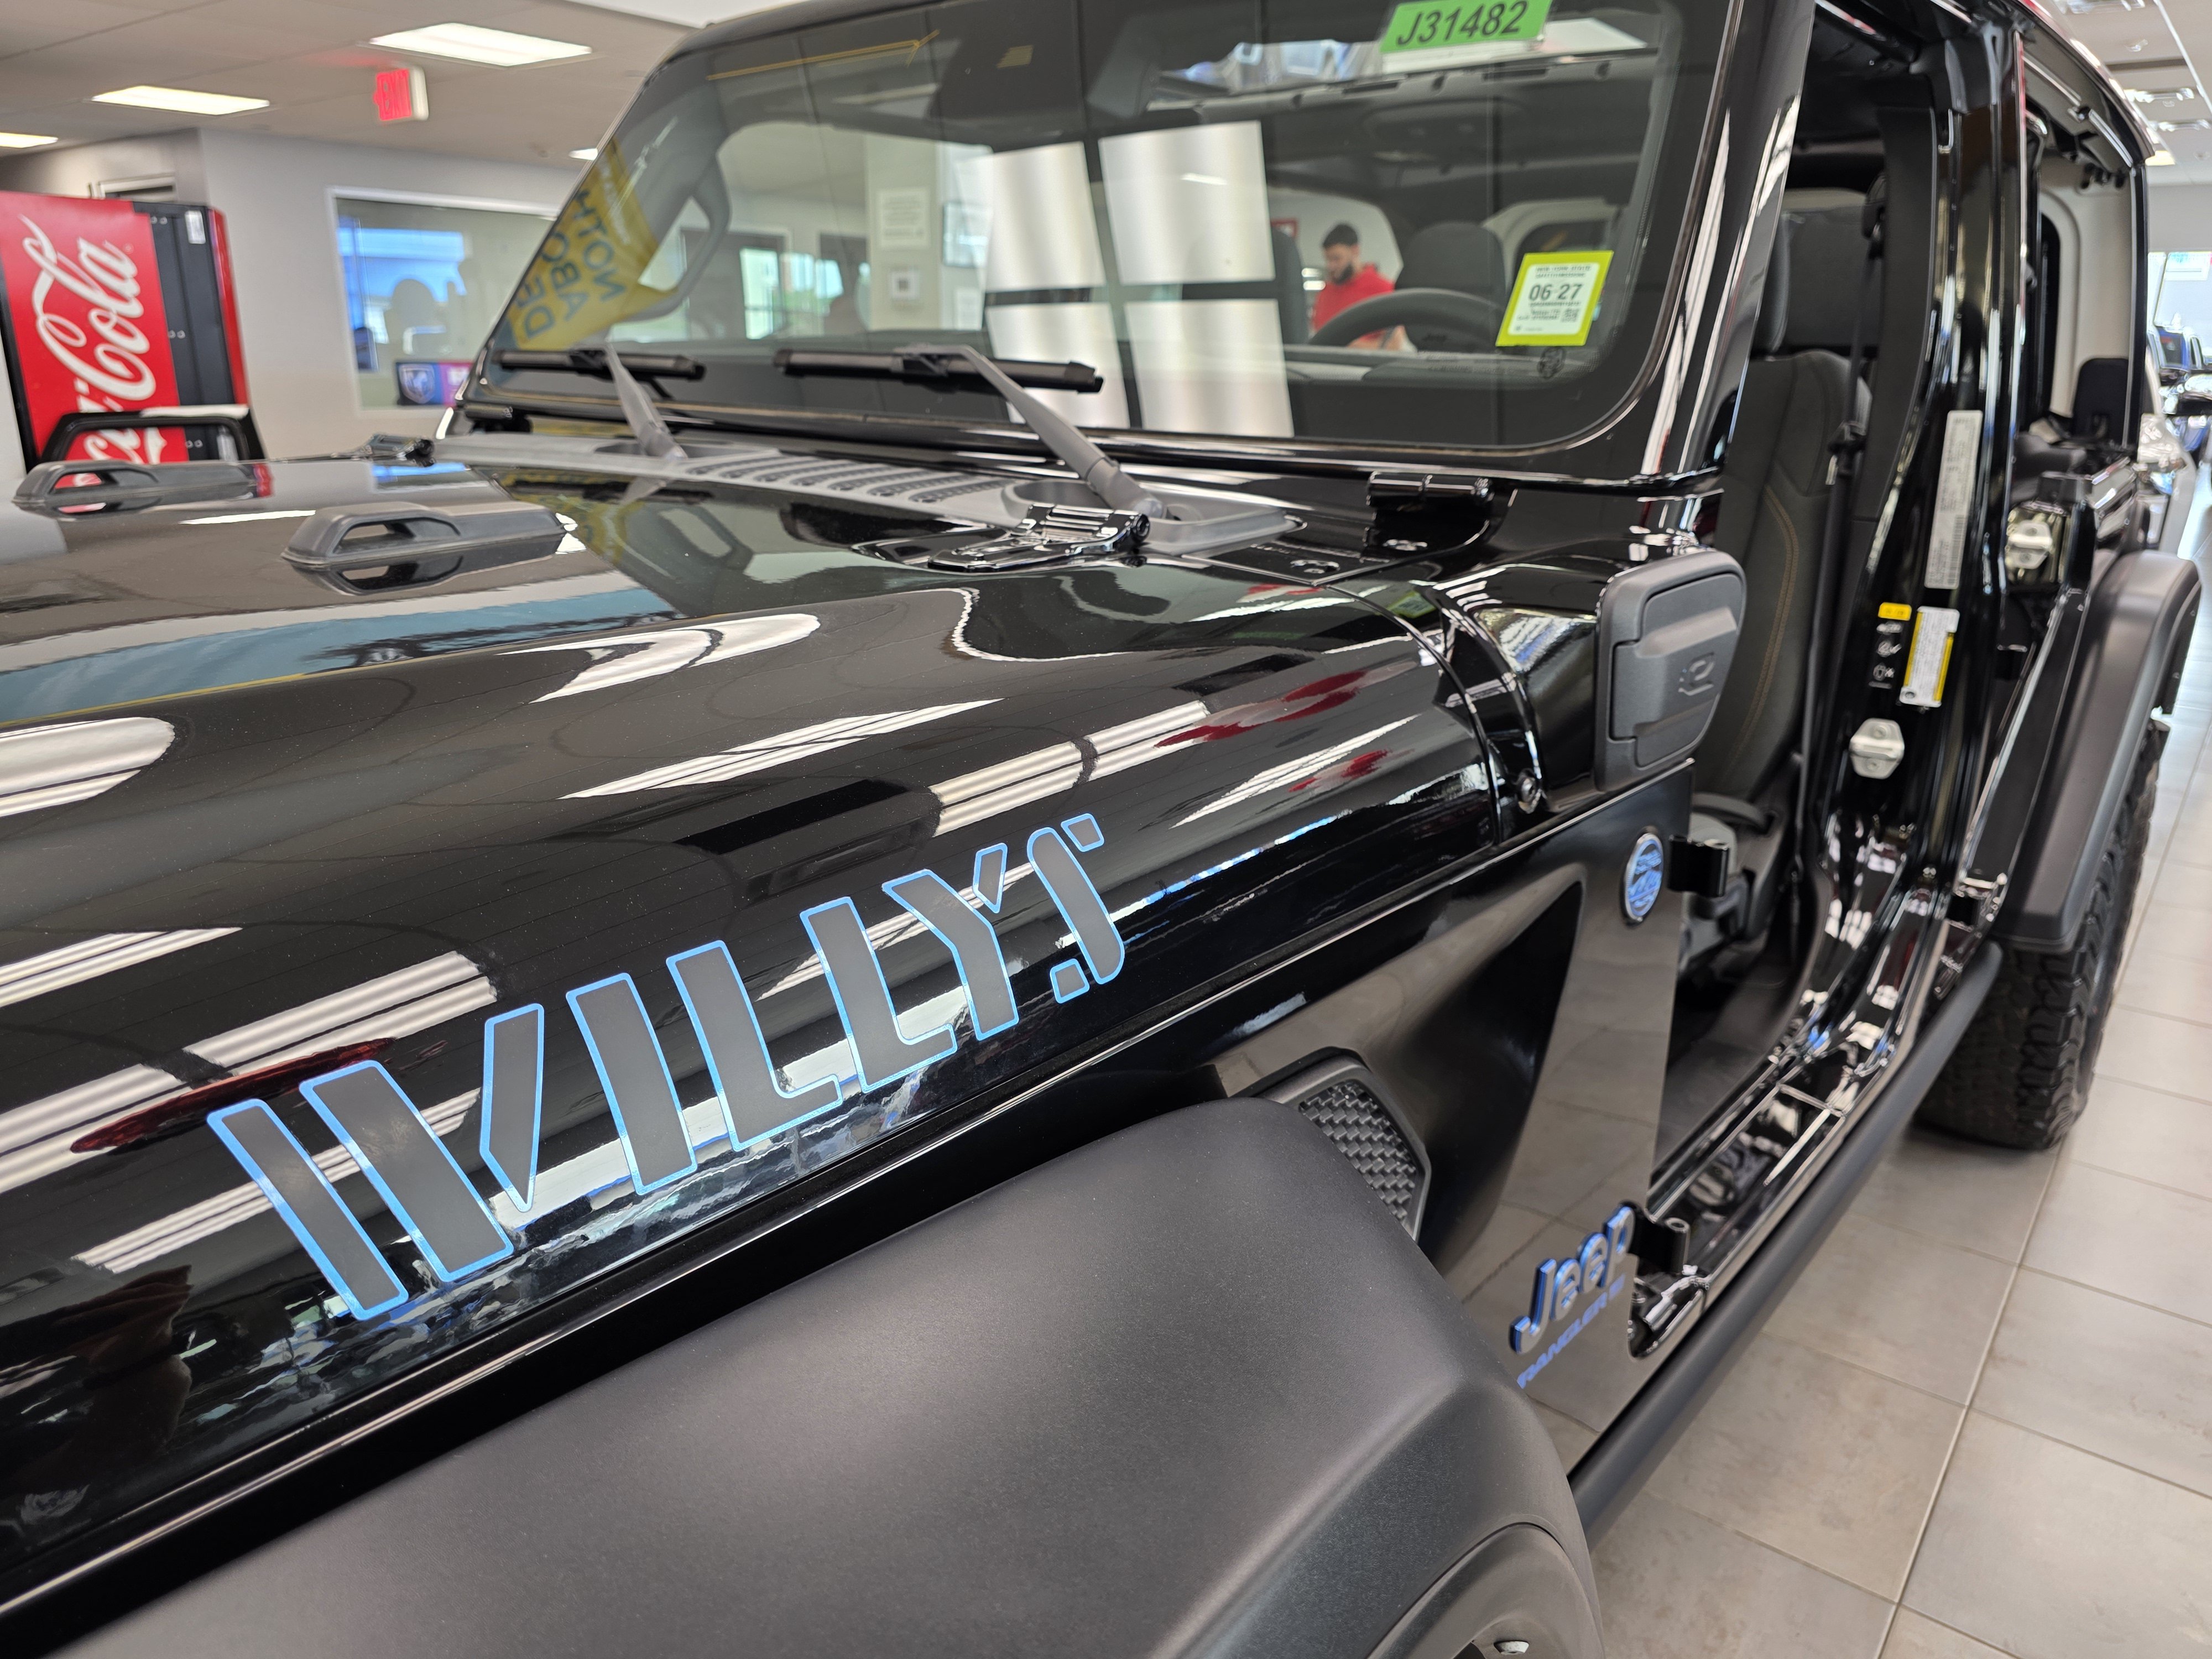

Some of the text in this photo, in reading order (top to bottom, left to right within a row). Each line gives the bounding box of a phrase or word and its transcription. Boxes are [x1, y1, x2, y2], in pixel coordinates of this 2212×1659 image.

[1397, 1, 1528, 45] J31482
[1528, 283, 1584, 300] 06 27
[207, 813, 1125, 1320] WILLYS
[1509, 1206, 1635, 1354] Jeep
[1516, 1292, 1608, 1389] RANGLER
